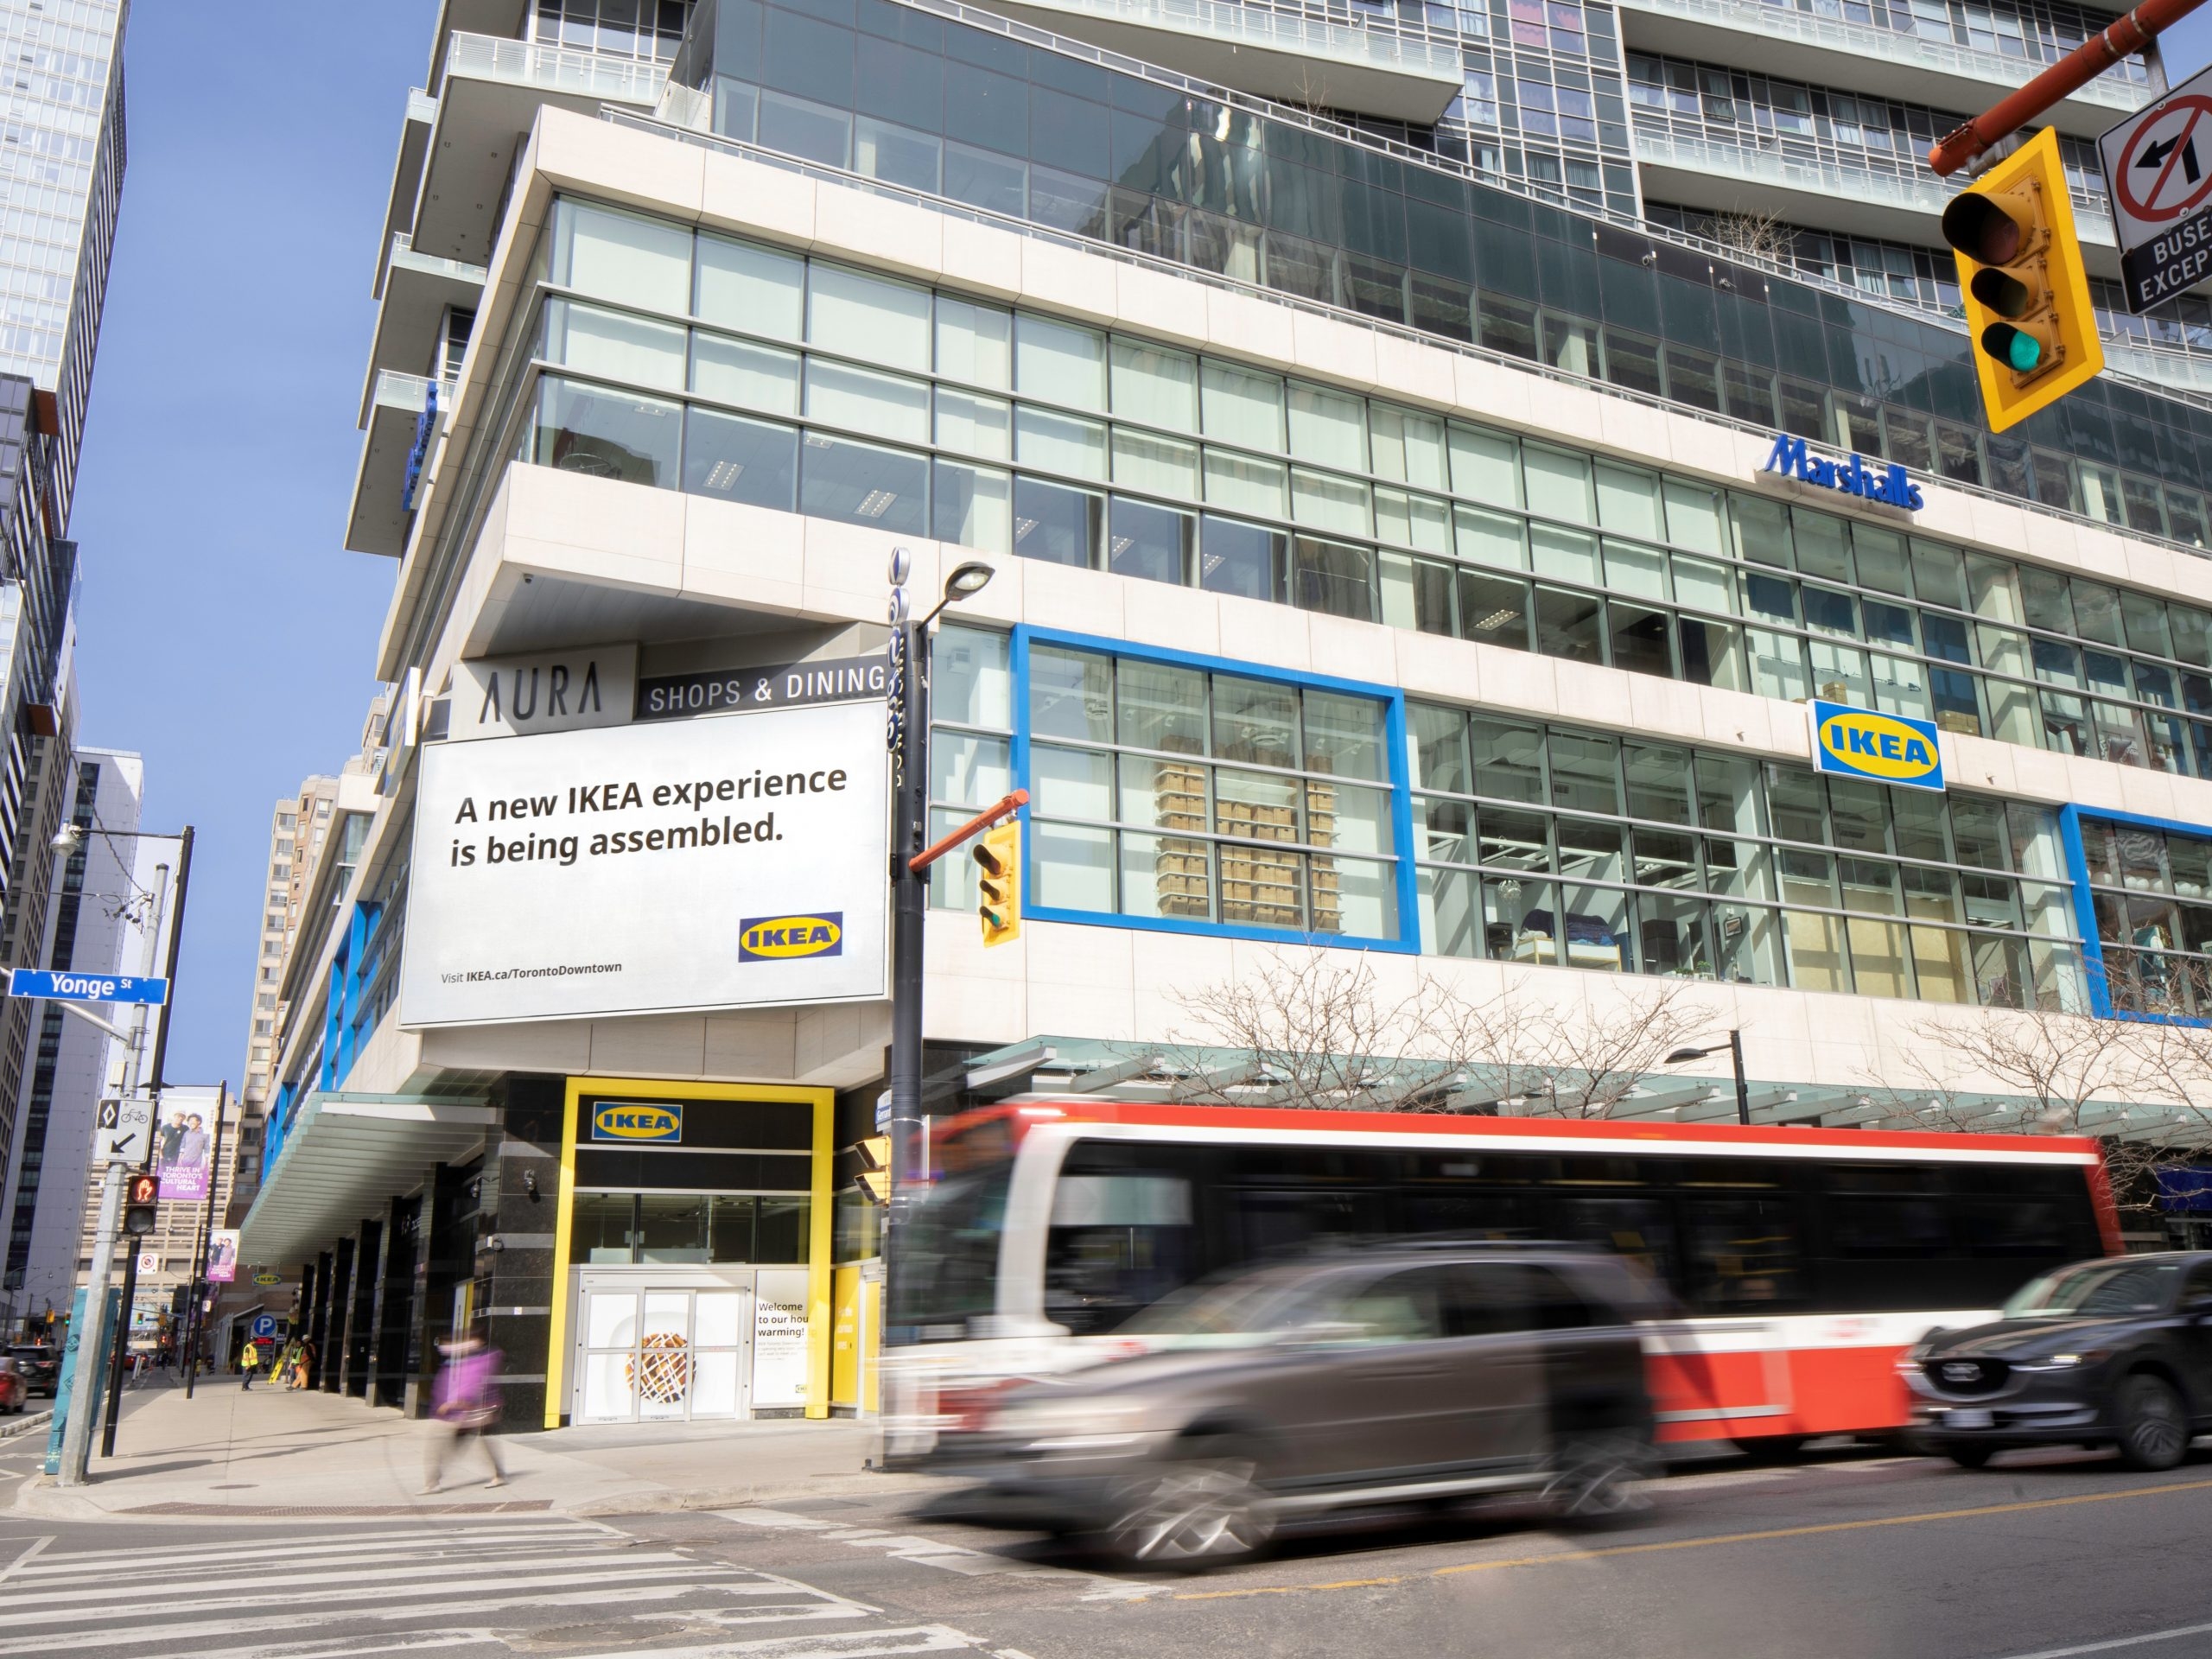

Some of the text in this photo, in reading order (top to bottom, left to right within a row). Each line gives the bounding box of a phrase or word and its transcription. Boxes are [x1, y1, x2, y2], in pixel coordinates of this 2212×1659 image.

[2153, 216, 2212, 264] BUSE
[2139, 244, 2212, 302] EXCEP
[1764, 433, 1924, 512] Marshalls
[479, 661, 601, 724] AURA
[650, 665, 885, 712] SHOPS & DINING
[1830, 724, 1931, 766] IKEA
[454, 768, 847, 824] A new IKEA experience
[451, 811, 783, 868] is being assembled.
[748, 925, 832, 948] IKEA
[50, 973, 132, 1000] Yonge St
[442, 963, 622, 983] Visit IKEA.ca/TorontoDowntown
[603, 1113, 674, 1129] IKEA
[759, 1302, 804, 1311] Welcome
[791, 1314, 809, 1324] hou
[758, 1327, 804, 1338] warming!
